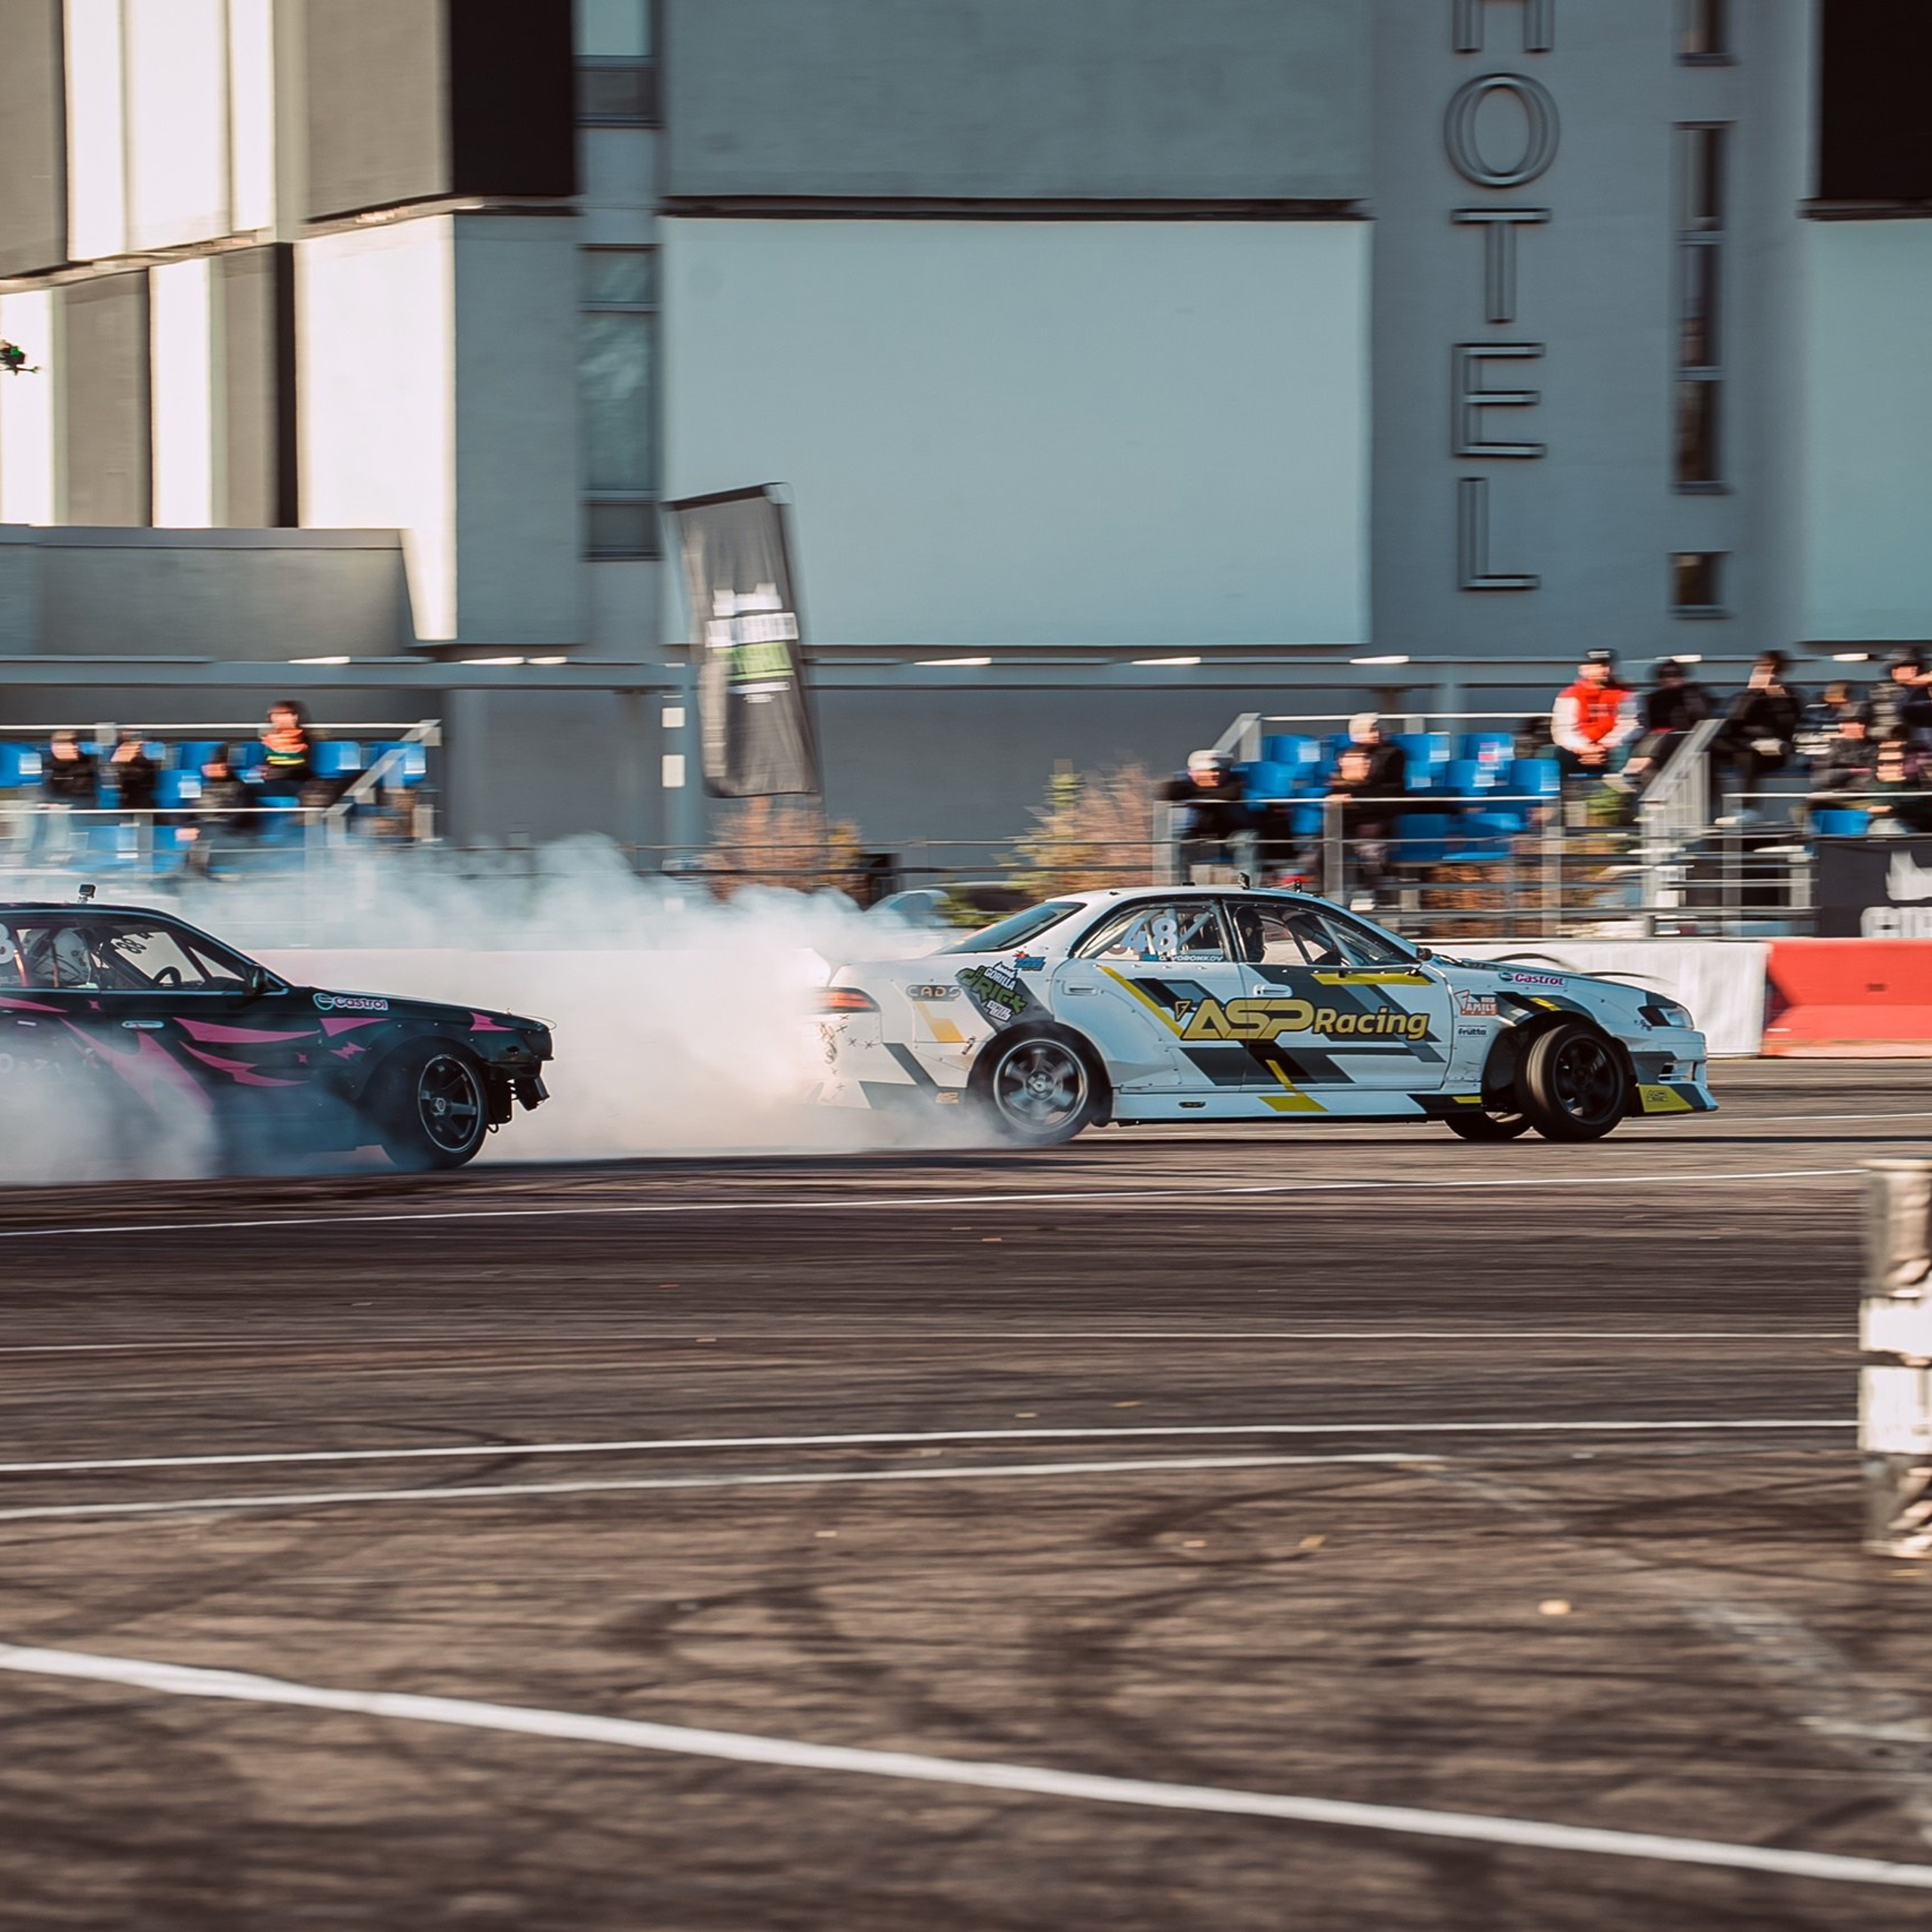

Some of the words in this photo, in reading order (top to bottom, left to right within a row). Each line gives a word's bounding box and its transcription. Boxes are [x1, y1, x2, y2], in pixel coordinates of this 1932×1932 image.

[1121, 918, 1178, 952] 48
[984, 968, 1017, 989] GORILLA
[1515, 973, 1564, 986] Castrol
[334, 995, 388, 1010] Castrol
[1182, 999, 1315, 1039] ASP
[1314, 1008, 1429, 1039] Racing
